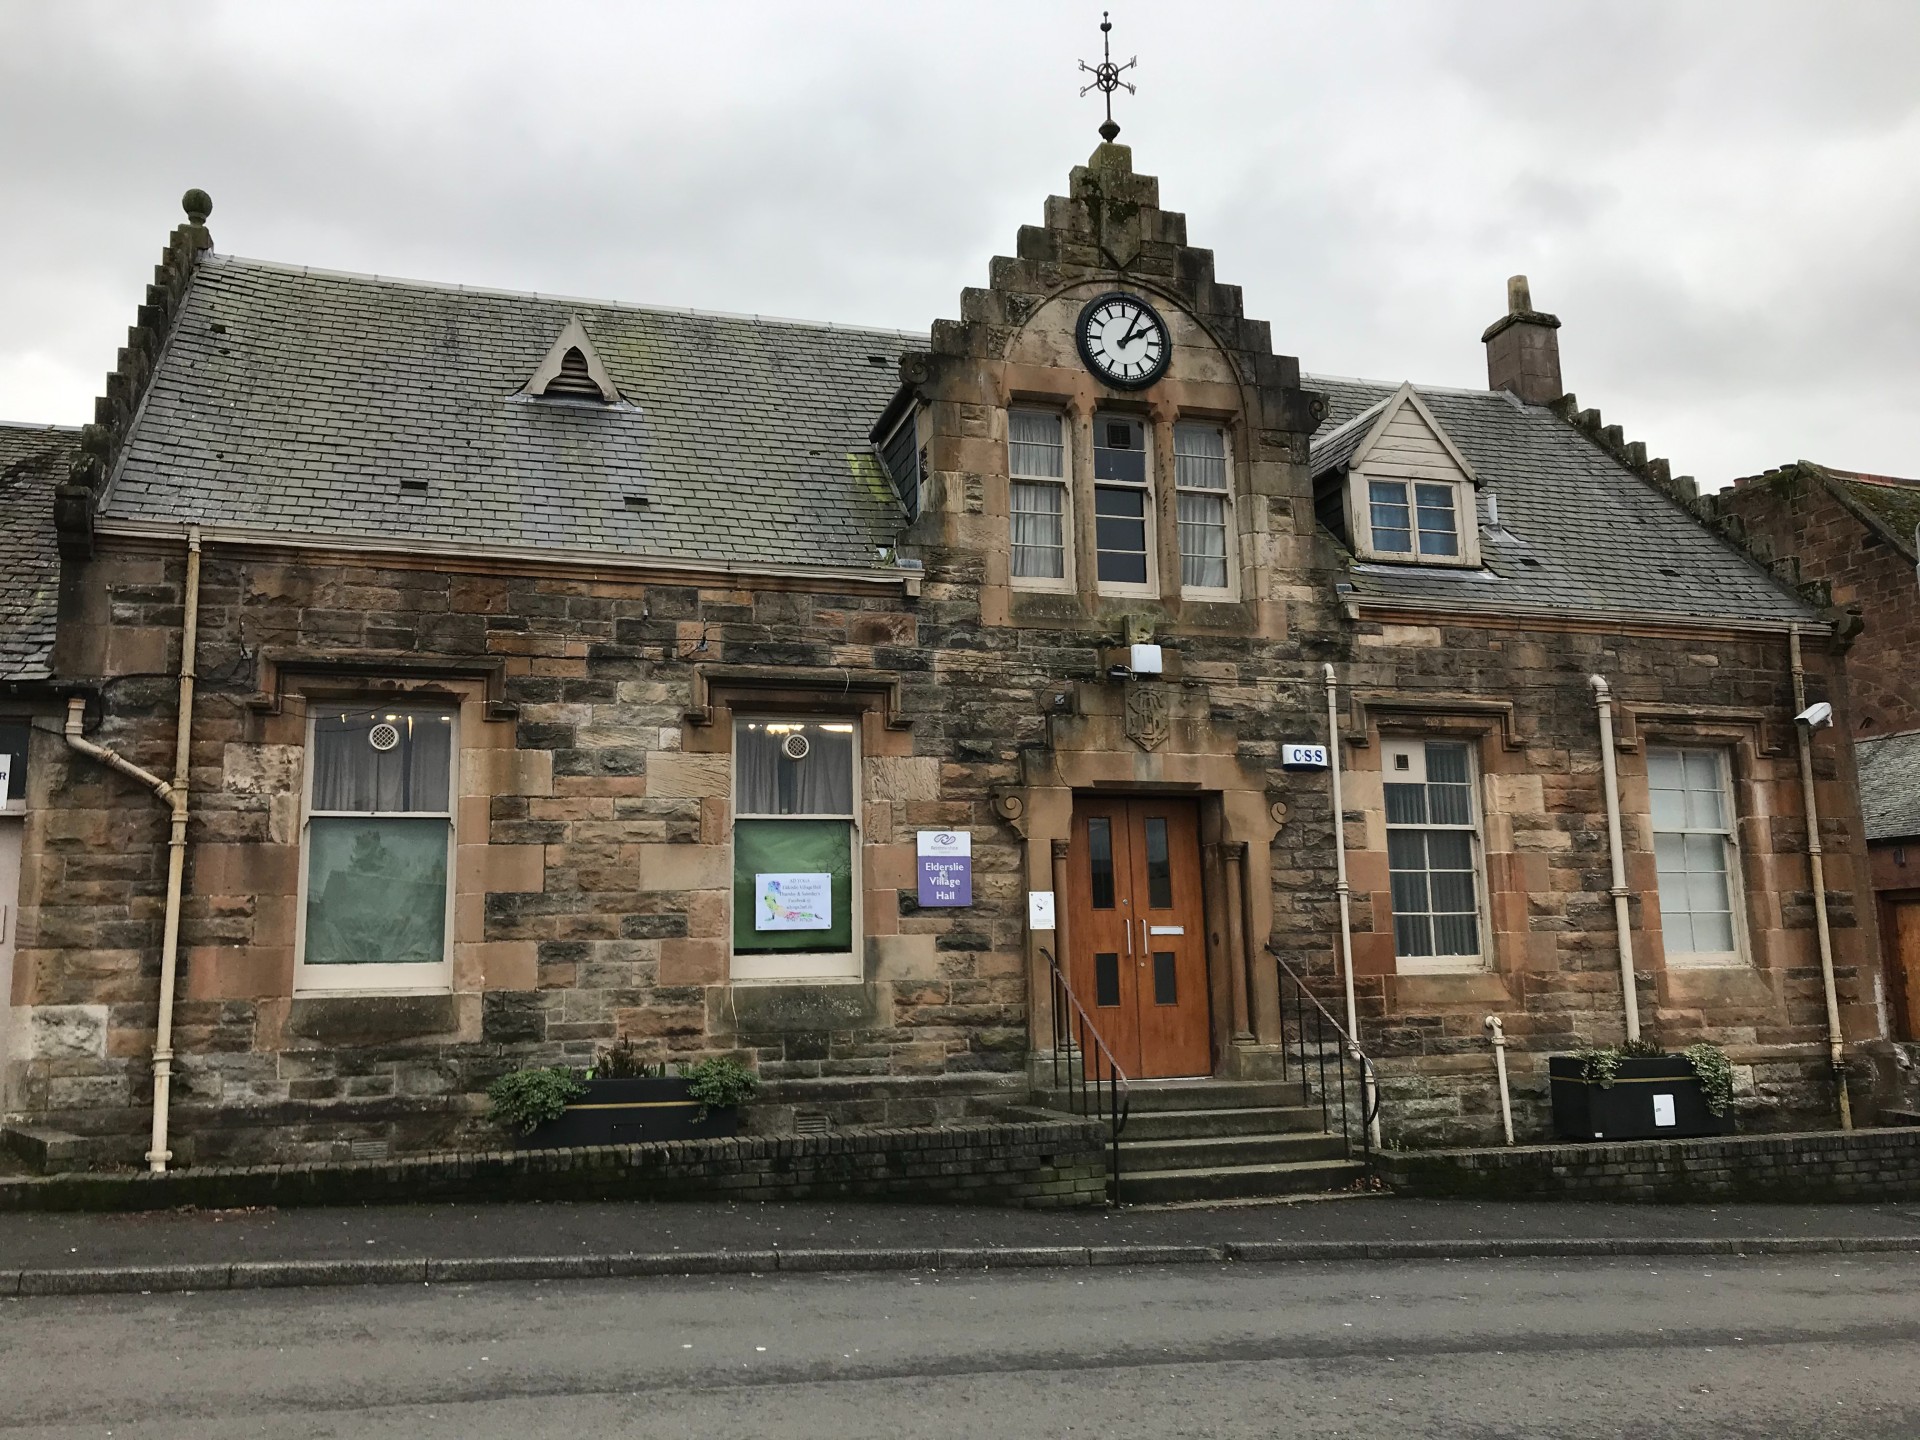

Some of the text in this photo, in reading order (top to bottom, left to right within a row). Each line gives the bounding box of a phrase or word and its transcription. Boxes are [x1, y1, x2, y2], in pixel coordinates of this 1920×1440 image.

[925, 862, 964, 871] Elderslie
[929, 876, 961, 888] Village
[936, 891, 955, 900] Hall
